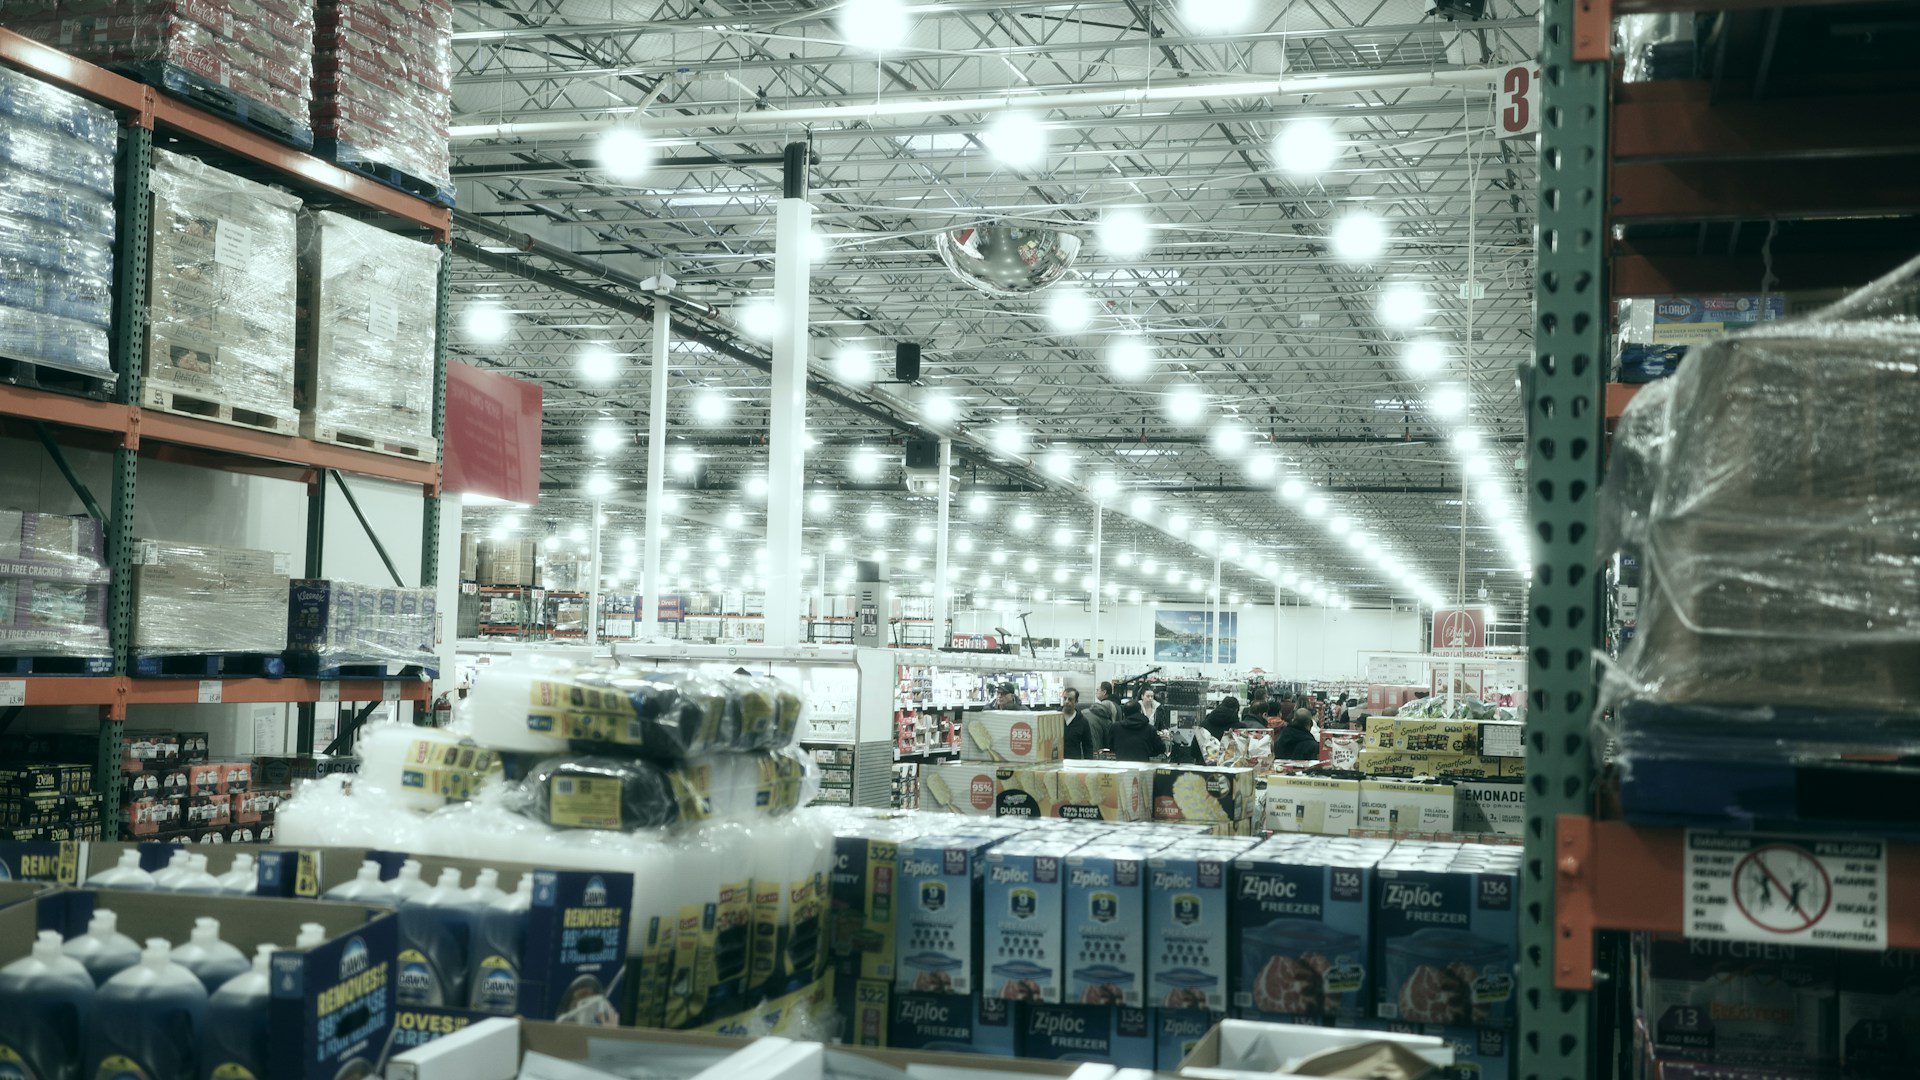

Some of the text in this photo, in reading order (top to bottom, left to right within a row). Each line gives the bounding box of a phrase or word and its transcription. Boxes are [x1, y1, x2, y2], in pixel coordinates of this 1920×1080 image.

[186, 51, 213, 73] Coca-Cola
[1658, 304, 1691, 316] CLOROX
[12, 564, 28, 575] FREE
[28, 565, 63, 577] CRACKERS
[297, 590, 326, 603] Kleenex
[1012, 731, 1031, 739] 95%
[1400, 724, 1437, 736] Smartfood
[1366, 755, 1403, 767] Smartfood
[1436, 758, 1472, 770] Smartfood
[972, 784, 992, 792] 95%
[1465, 789, 1525, 802] EMONADE
[1693, 836, 1751, 849] DANGER
[870, 846, 897, 861] 322
[945, 851, 965, 862] 136
[1815, 843, 1879, 857] PELIGRO
[903, 859, 939, 878] Ziploc
[1036, 858, 1056, 870] 136
[1116, 861, 1136, 873] 136
[1199, 863, 1220, 876] 136
[992, 867, 1029, 885] Ziploc
[1072, 870, 1109, 889] Ziploc
[1154, 872, 1192, 891] Ziploc
[1335, 873, 1359, 887] 136
[1243, 875, 1297, 901] Ziploc
[1482, 881, 1508, 896] 136
[1019, 893, 1028, 906] 9
[1099, 896, 1109, 910] 9
[1388, 884, 1443, 910] Ziploc
[1182, 899, 1192, 913] 9
[1261, 901, 1321, 915] FREEZER
[1405, 911, 1467, 924] FREEZER
[1863, 919, 1877, 928] LA
[1690, 940, 1796, 960] KITCHEN
[317, 967, 379, 1018] REMOVES
[860, 988, 885, 1003] 322
[902, 1000, 949, 1024] Ziploc
[1121, 1009, 1144, 1022] 136
[1674, 1008, 1699, 1027] 13
[1035, 1011, 1085, 1035] Ziploc
[1165, 1019, 1203, 1037] Ziploc
[916, 1026, 970, 1039] FREEZER
[1480, 1030, 1502, 1043] 136
[1051, 1036, 1107, 1050] FREEZER
[1683, 1035, 1709, 1046] BAGS
